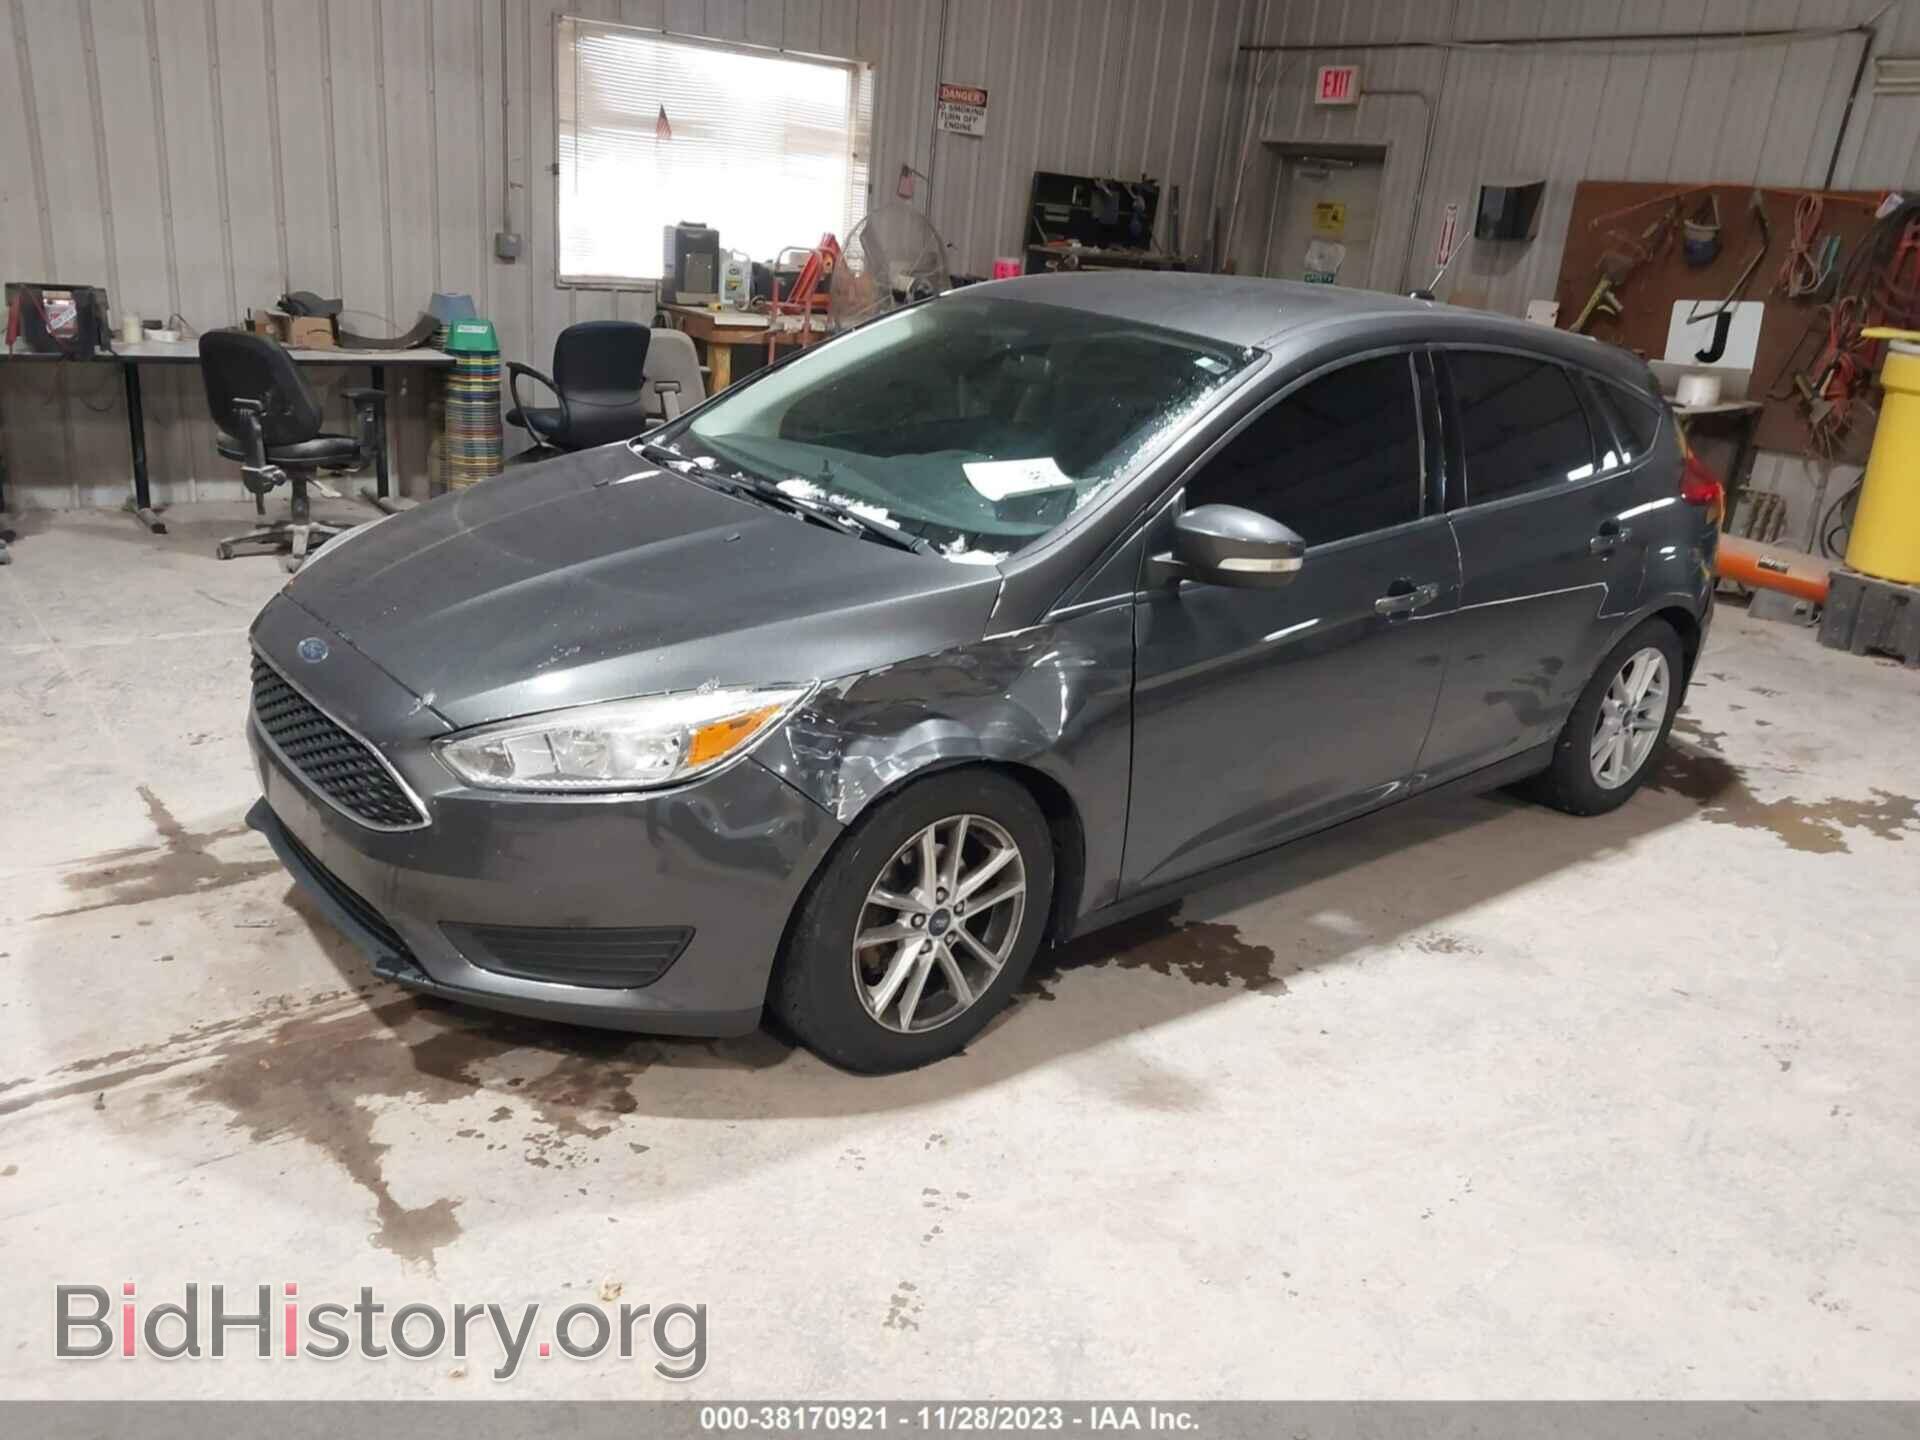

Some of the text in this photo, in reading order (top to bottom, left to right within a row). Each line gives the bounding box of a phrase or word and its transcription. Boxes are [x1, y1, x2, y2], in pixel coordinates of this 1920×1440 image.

[1322, 69, 1352, 98] EXIT
[943, 87, 982, 103] DANGER
[940, 112, 979, 125] TURN OFF
[944, 121, 972, 132] ENGINE
[1694, 311, 1732, 363] J
